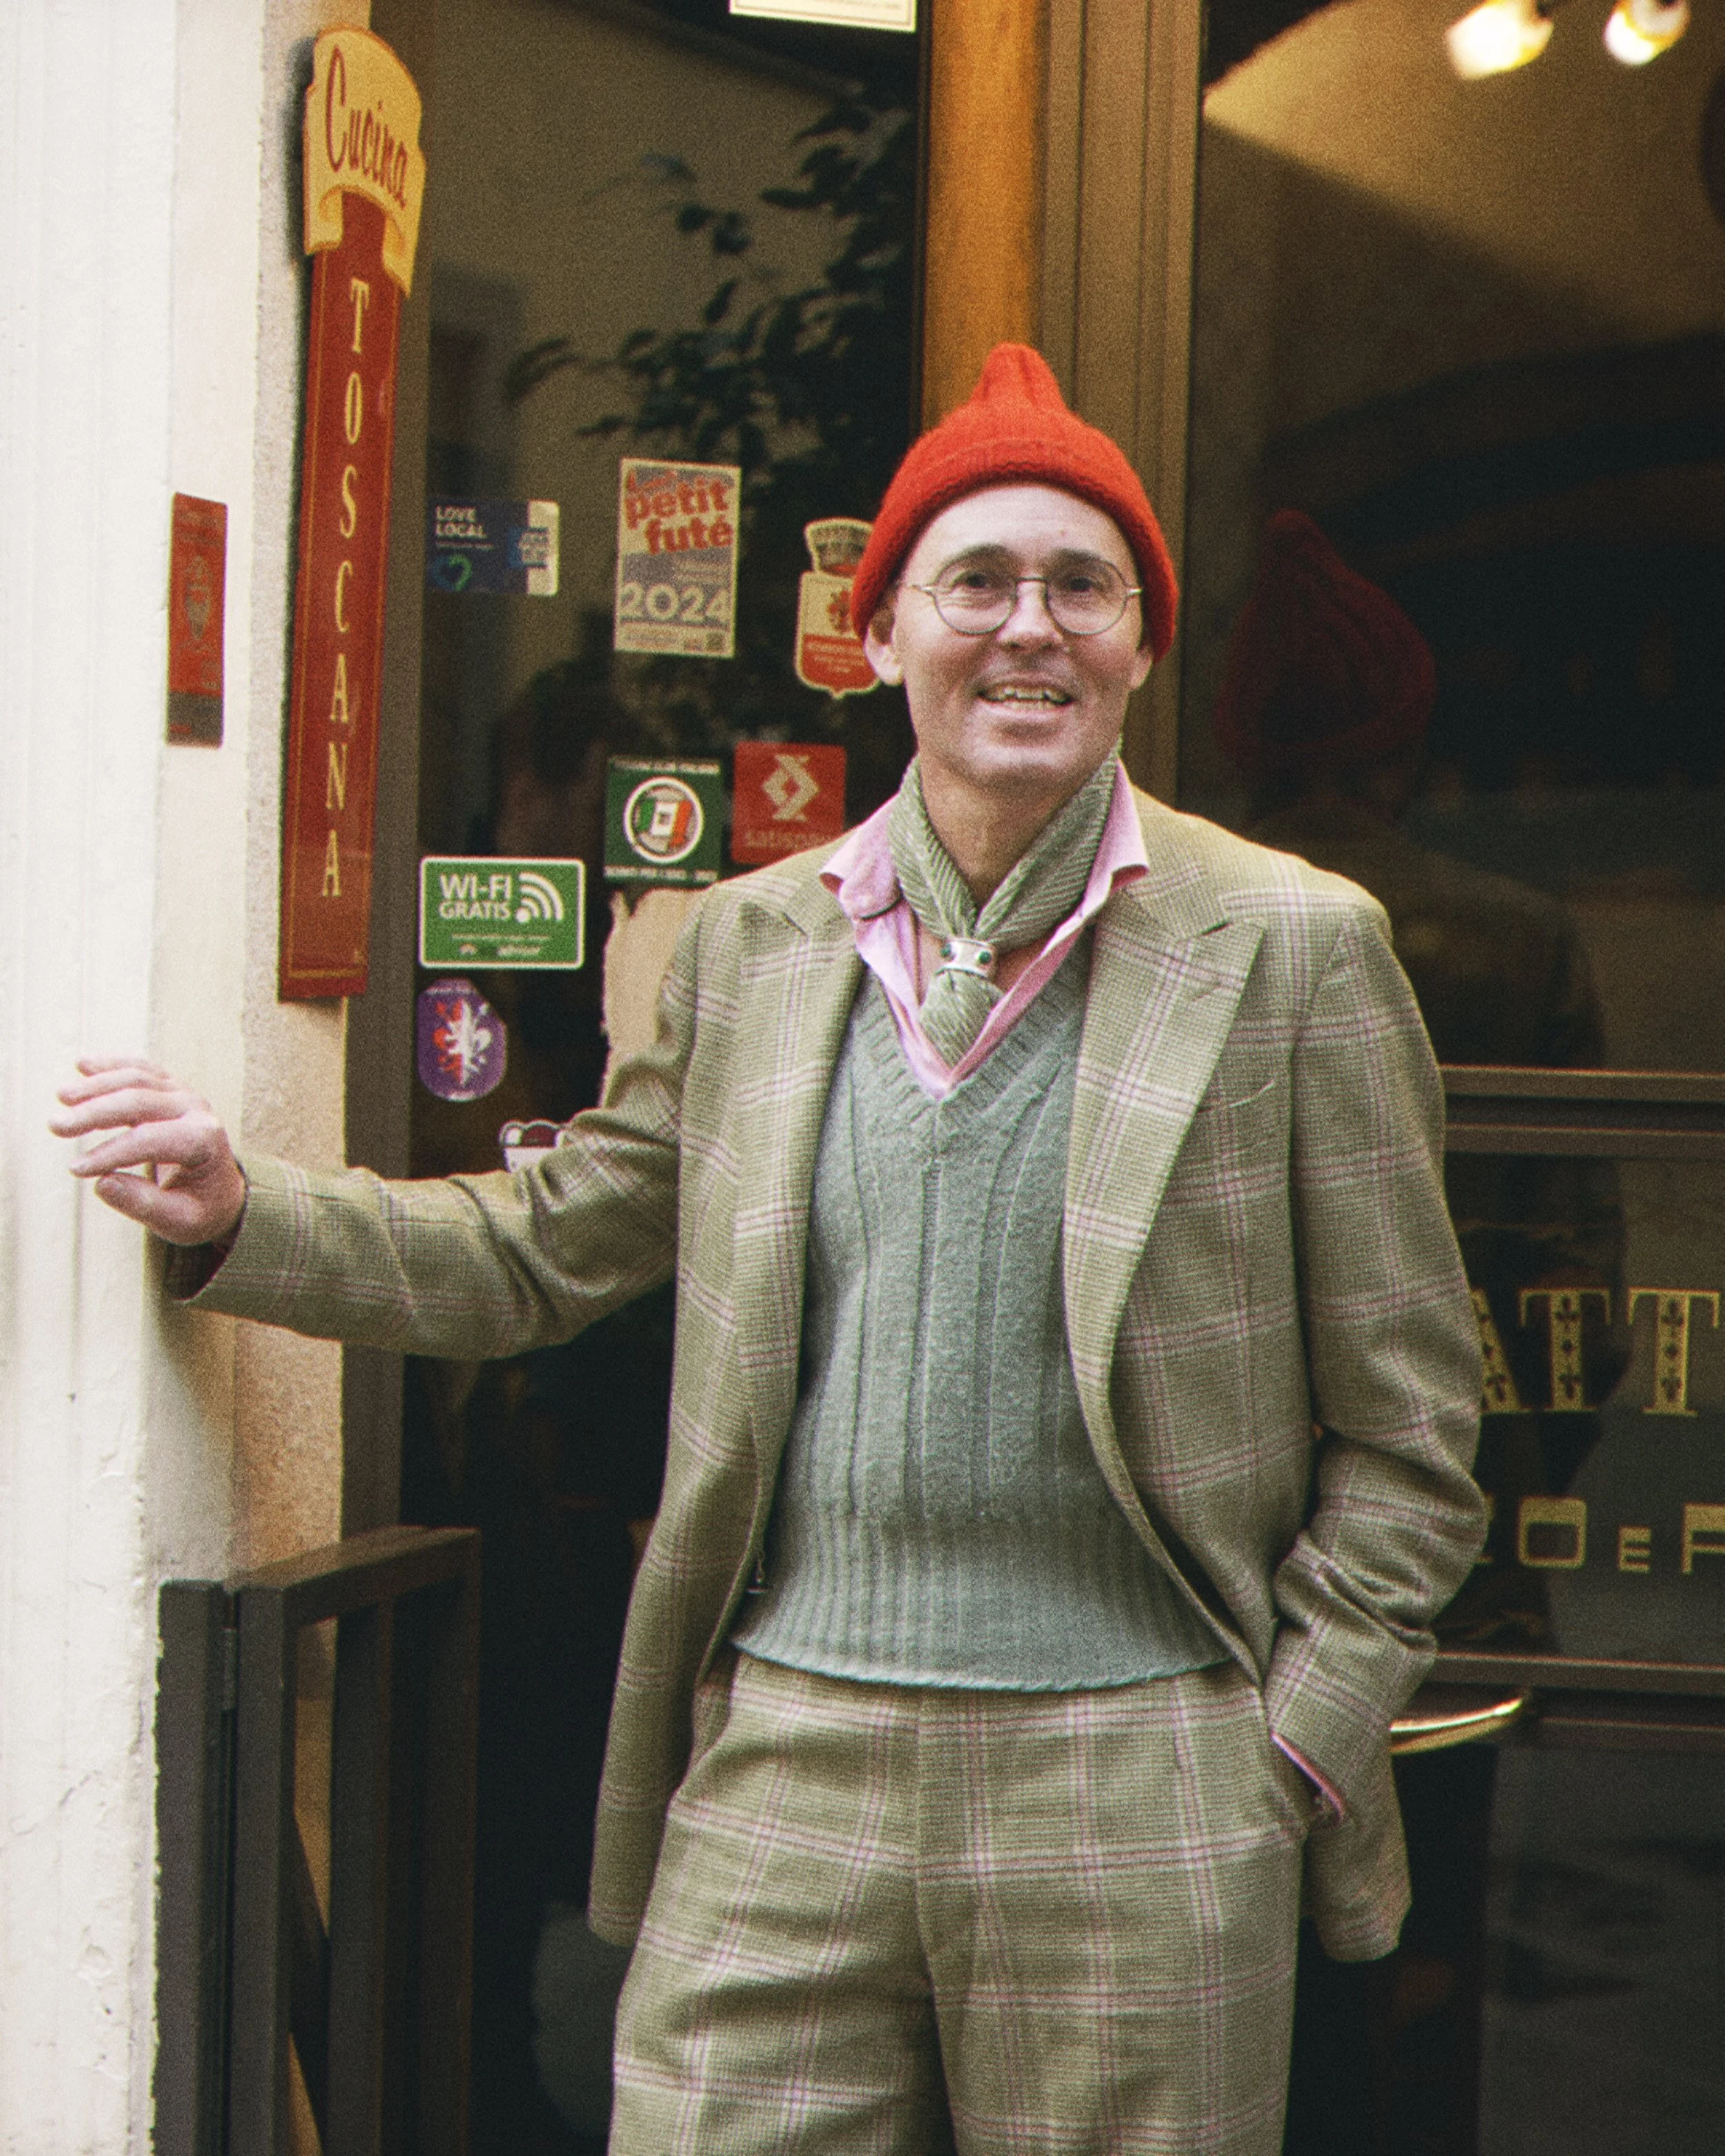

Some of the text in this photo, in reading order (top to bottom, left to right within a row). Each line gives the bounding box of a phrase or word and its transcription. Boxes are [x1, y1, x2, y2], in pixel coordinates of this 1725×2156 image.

[326, 43, 409, 210] Cucina
[435, 505, 477, 522] LOVE
[624, 476, 730, 531] petit
[435, 522, 488, 539] LOCAL
[322, 277, 370, 898] TOSCANA
[619, 580, 730, 626] 2024
[439, 873, 512, 900] WI-FI
[438, 900, 512, 921] GRATIS
